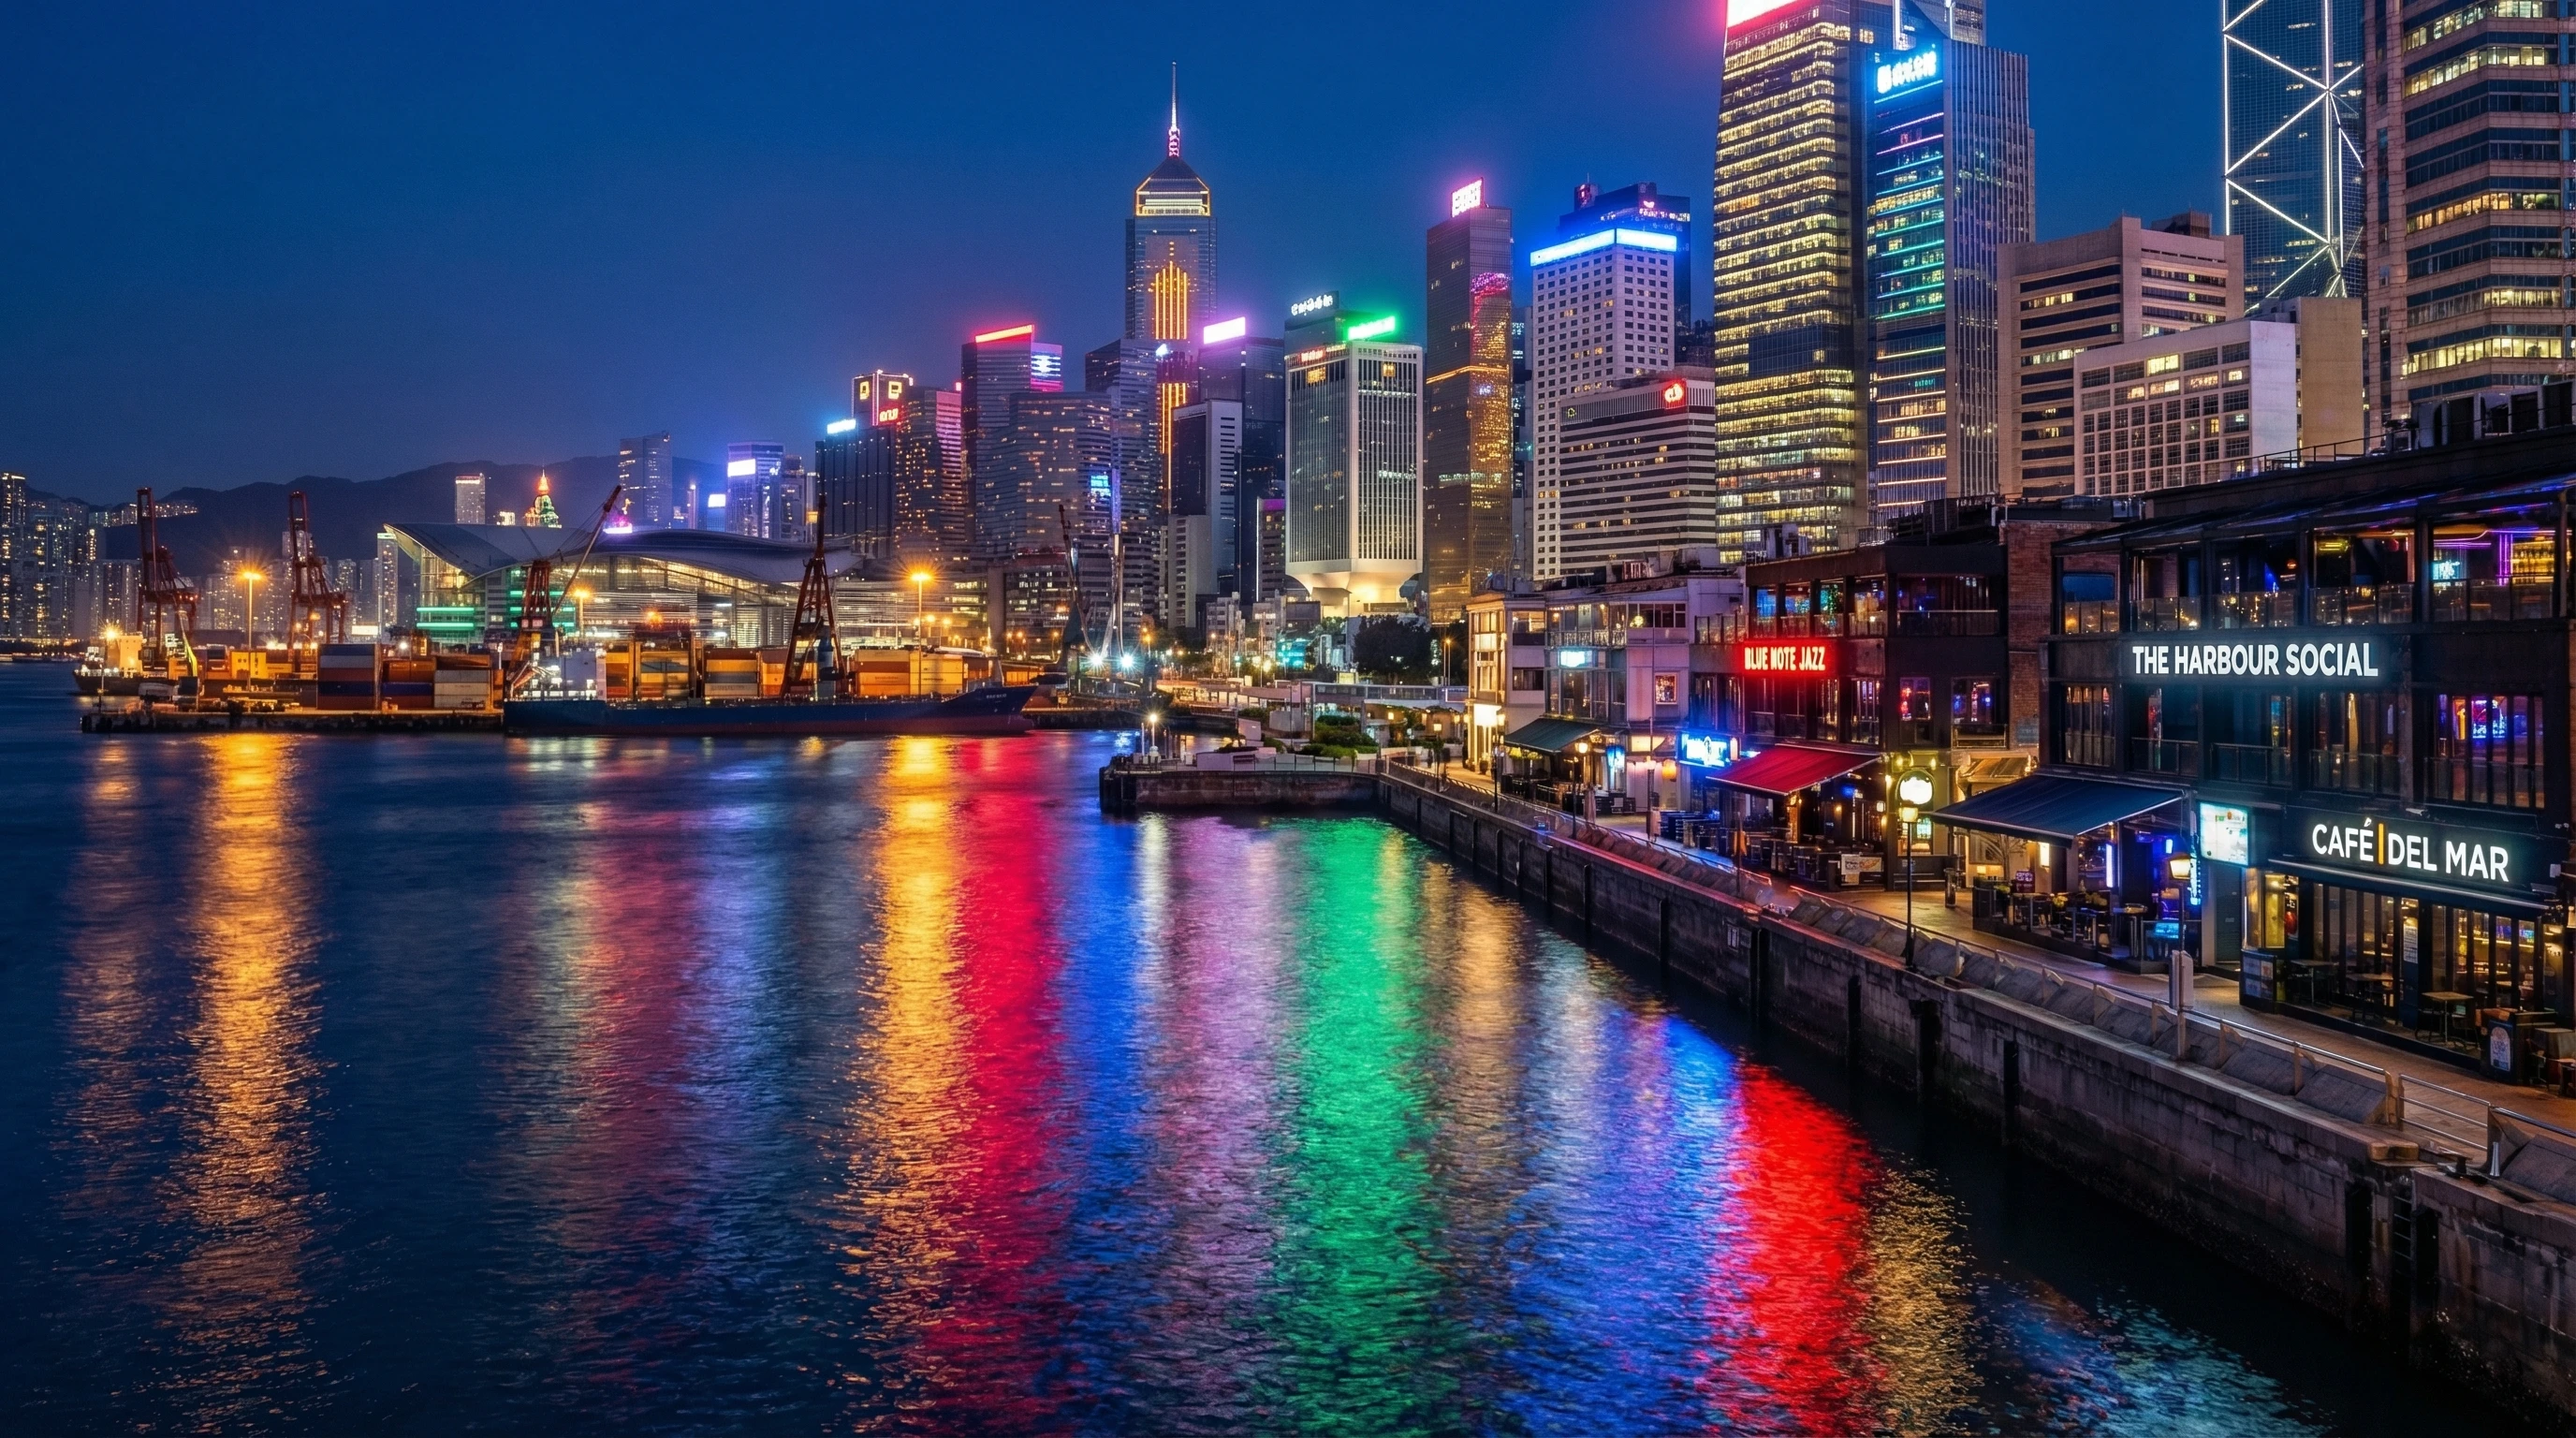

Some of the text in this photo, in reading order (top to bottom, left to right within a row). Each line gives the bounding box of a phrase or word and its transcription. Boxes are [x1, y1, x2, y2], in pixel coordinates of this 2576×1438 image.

[1745, 646, 1825, 670] BLUE NOTE JAZZ
[2132, 642, 2378, 676] THE HARBOUR SOCIAL
[2312, 817, 2510, 882] CAFÉ DEL MAR
